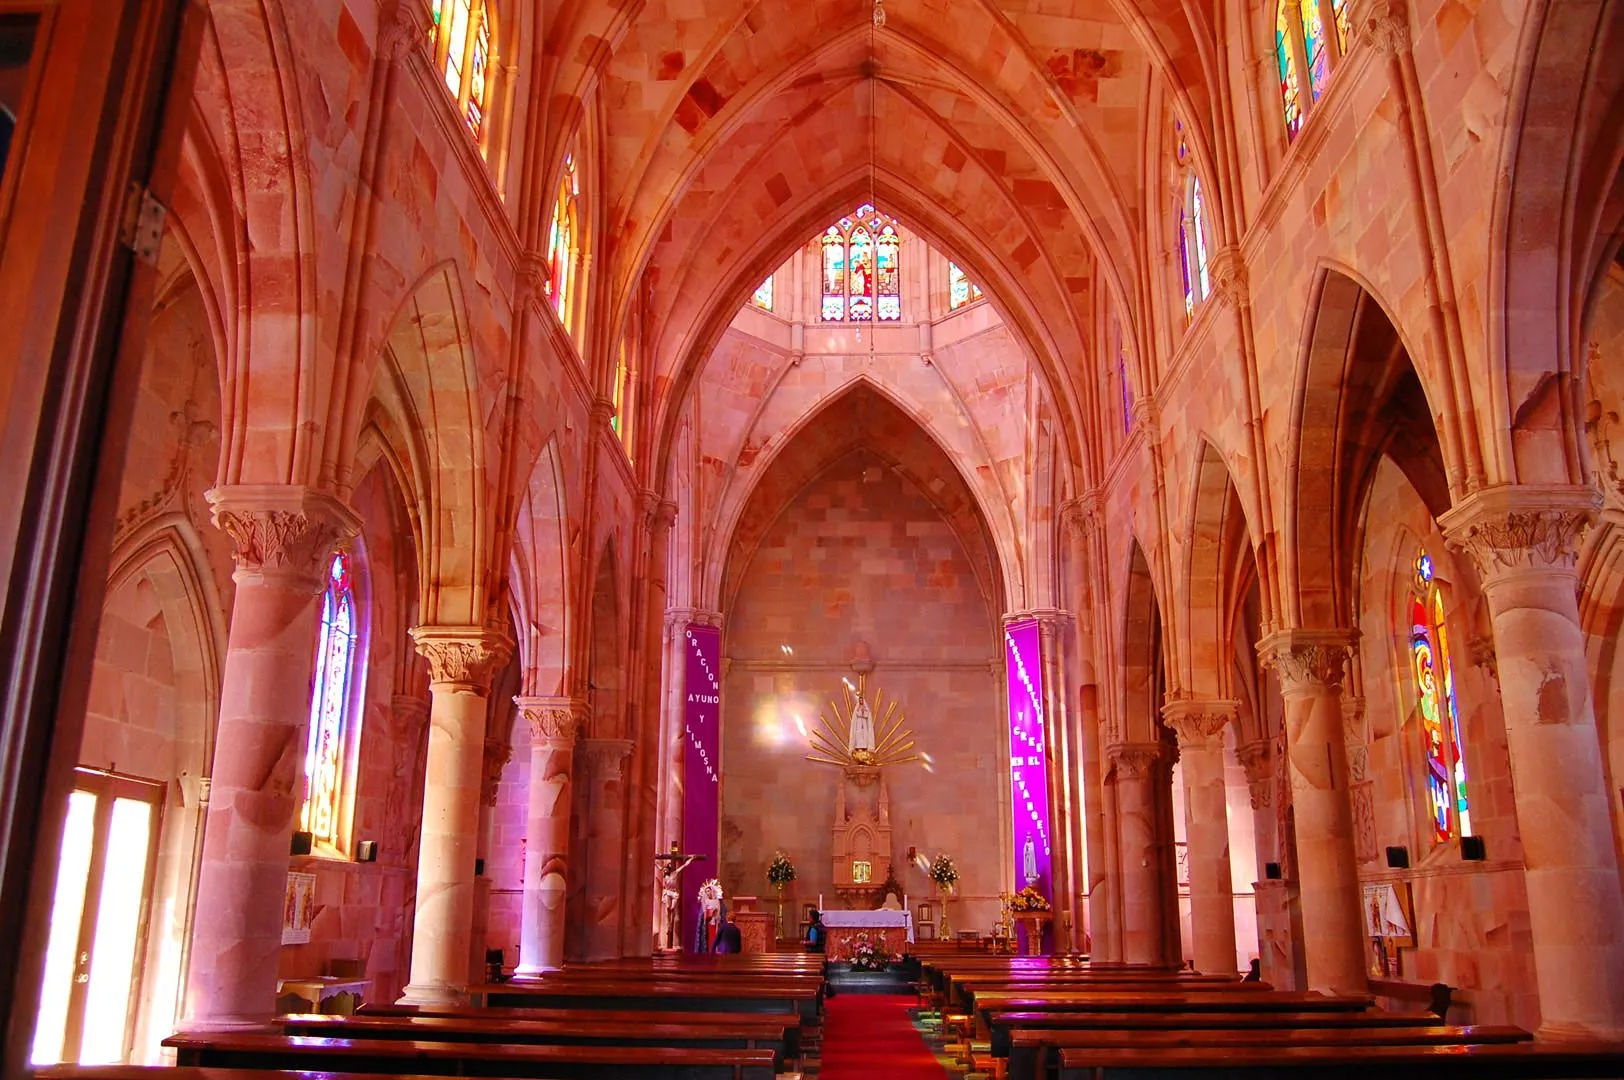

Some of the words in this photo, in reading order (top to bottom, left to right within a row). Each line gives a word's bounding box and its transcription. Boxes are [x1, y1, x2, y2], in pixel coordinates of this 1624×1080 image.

[686, 630, 719, 690] ORACION
[687, 693, 720, 704] AYUNO
[699, 714, 705, 723] Y
[686, 723, 719, 782] LIMOSNA
[1013, 725, 1043, 753] CREE
[1027, 755, 1041, 766] EL
[1013, 771, 1051, 856] EVANGELIO
